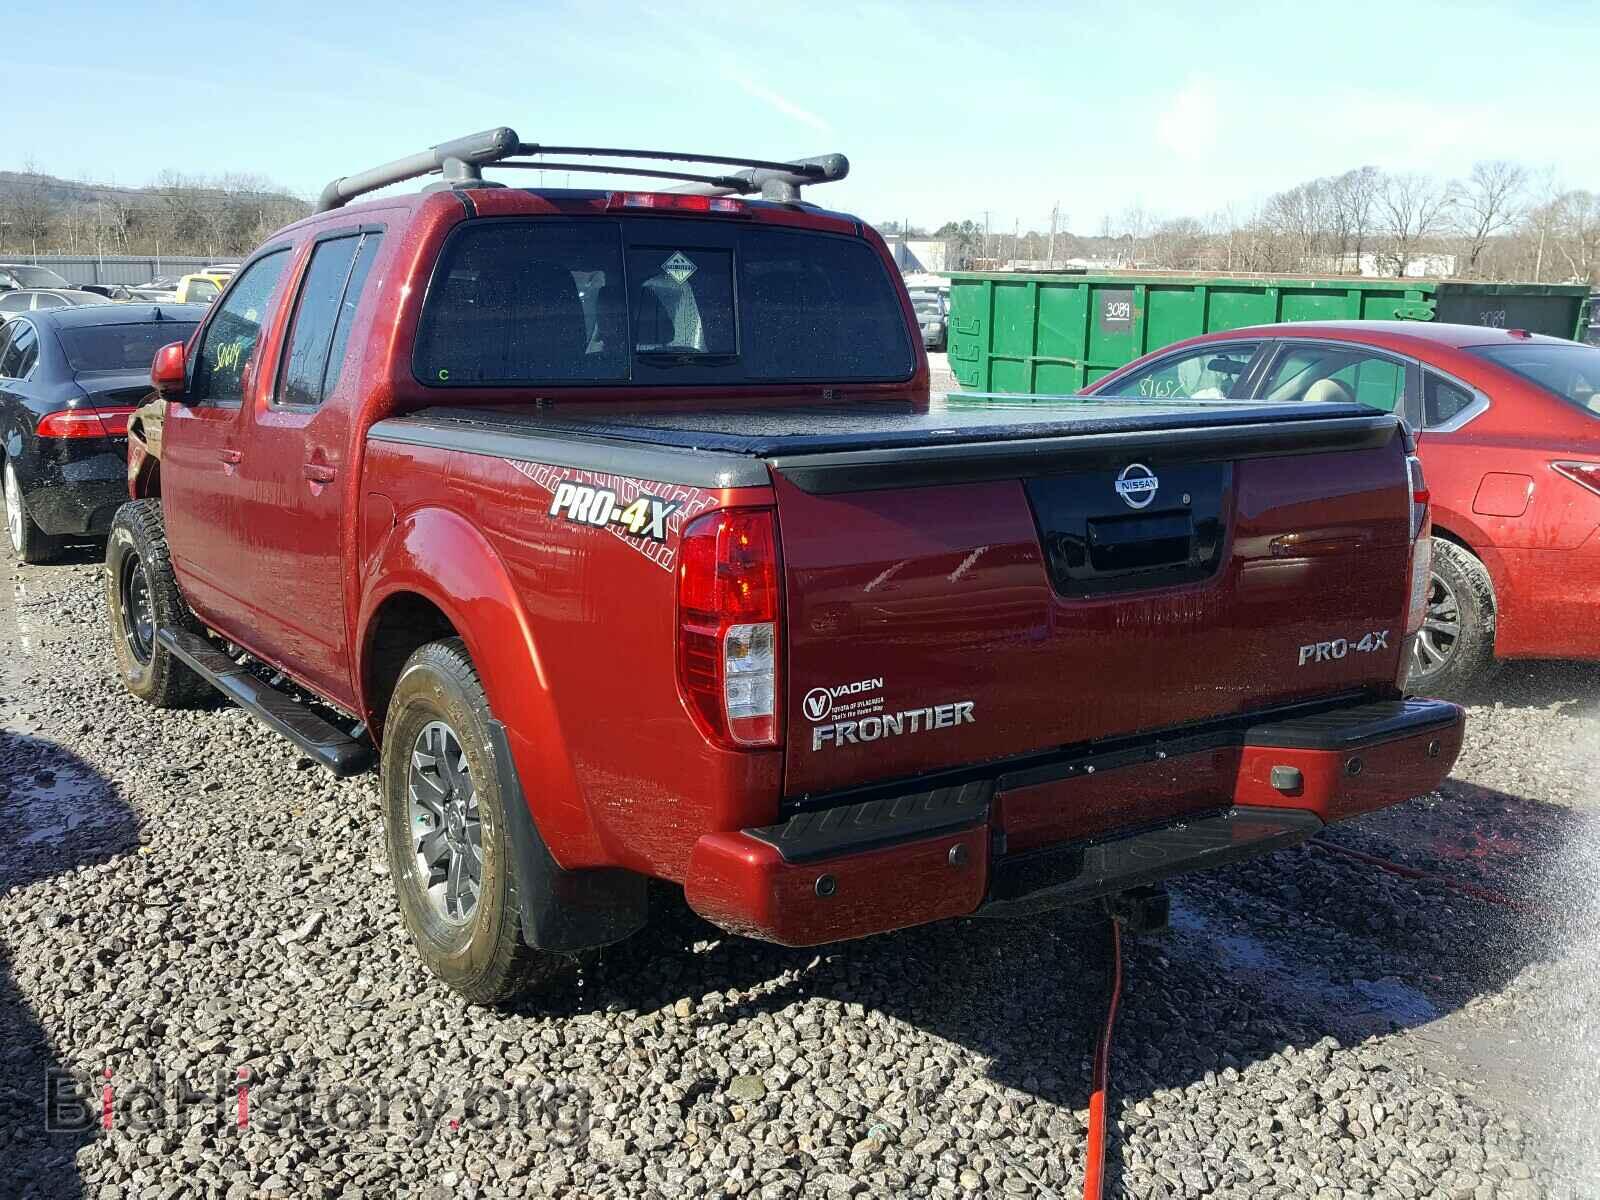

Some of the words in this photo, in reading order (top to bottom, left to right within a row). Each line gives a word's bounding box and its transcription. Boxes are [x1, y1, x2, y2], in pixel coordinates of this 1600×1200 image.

[1105, 302, 1130, 319] 3089
[1120, 478, 1158, 491] NISSAN
[549, 482, 677, 540] PRO-4X
[1298, 630, 1390, 666] PRO-4X
[829, 677, 884, 698] VADEN
[831, 704, 850, 713] TOYOTA
[811, 701, 977, 752] FRONTIER
